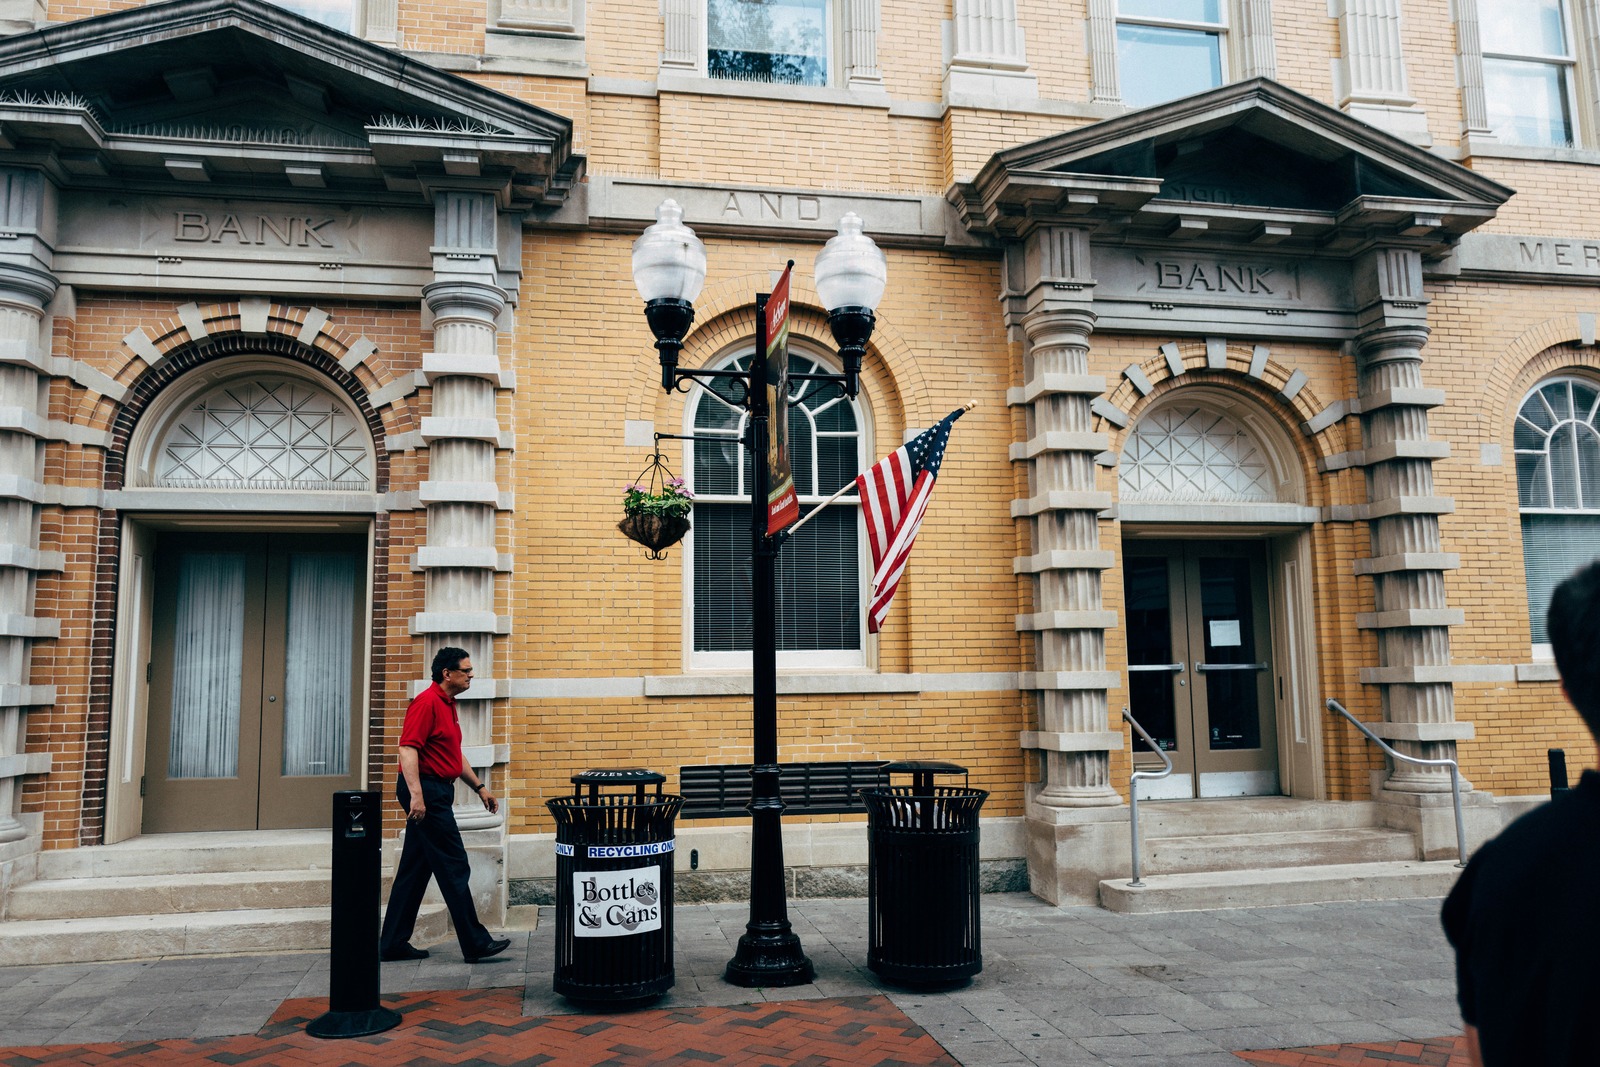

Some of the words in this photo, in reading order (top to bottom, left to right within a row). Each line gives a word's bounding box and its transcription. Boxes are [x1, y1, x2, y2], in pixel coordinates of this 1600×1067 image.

[721, 191, 820, 221] AND
[175, 211, 335, 248] BANK
[1519, 242, 1600, 269] MER
[1155, 261, 1274, 295] BANK
[589, 844, 659, 857] RECYCLING
[661, 842, 675, 852] ONL
[581, 878, 655, 901] Bottles
[579, 905, 600, 927] &
[606, 904, 658, 926] Cans
